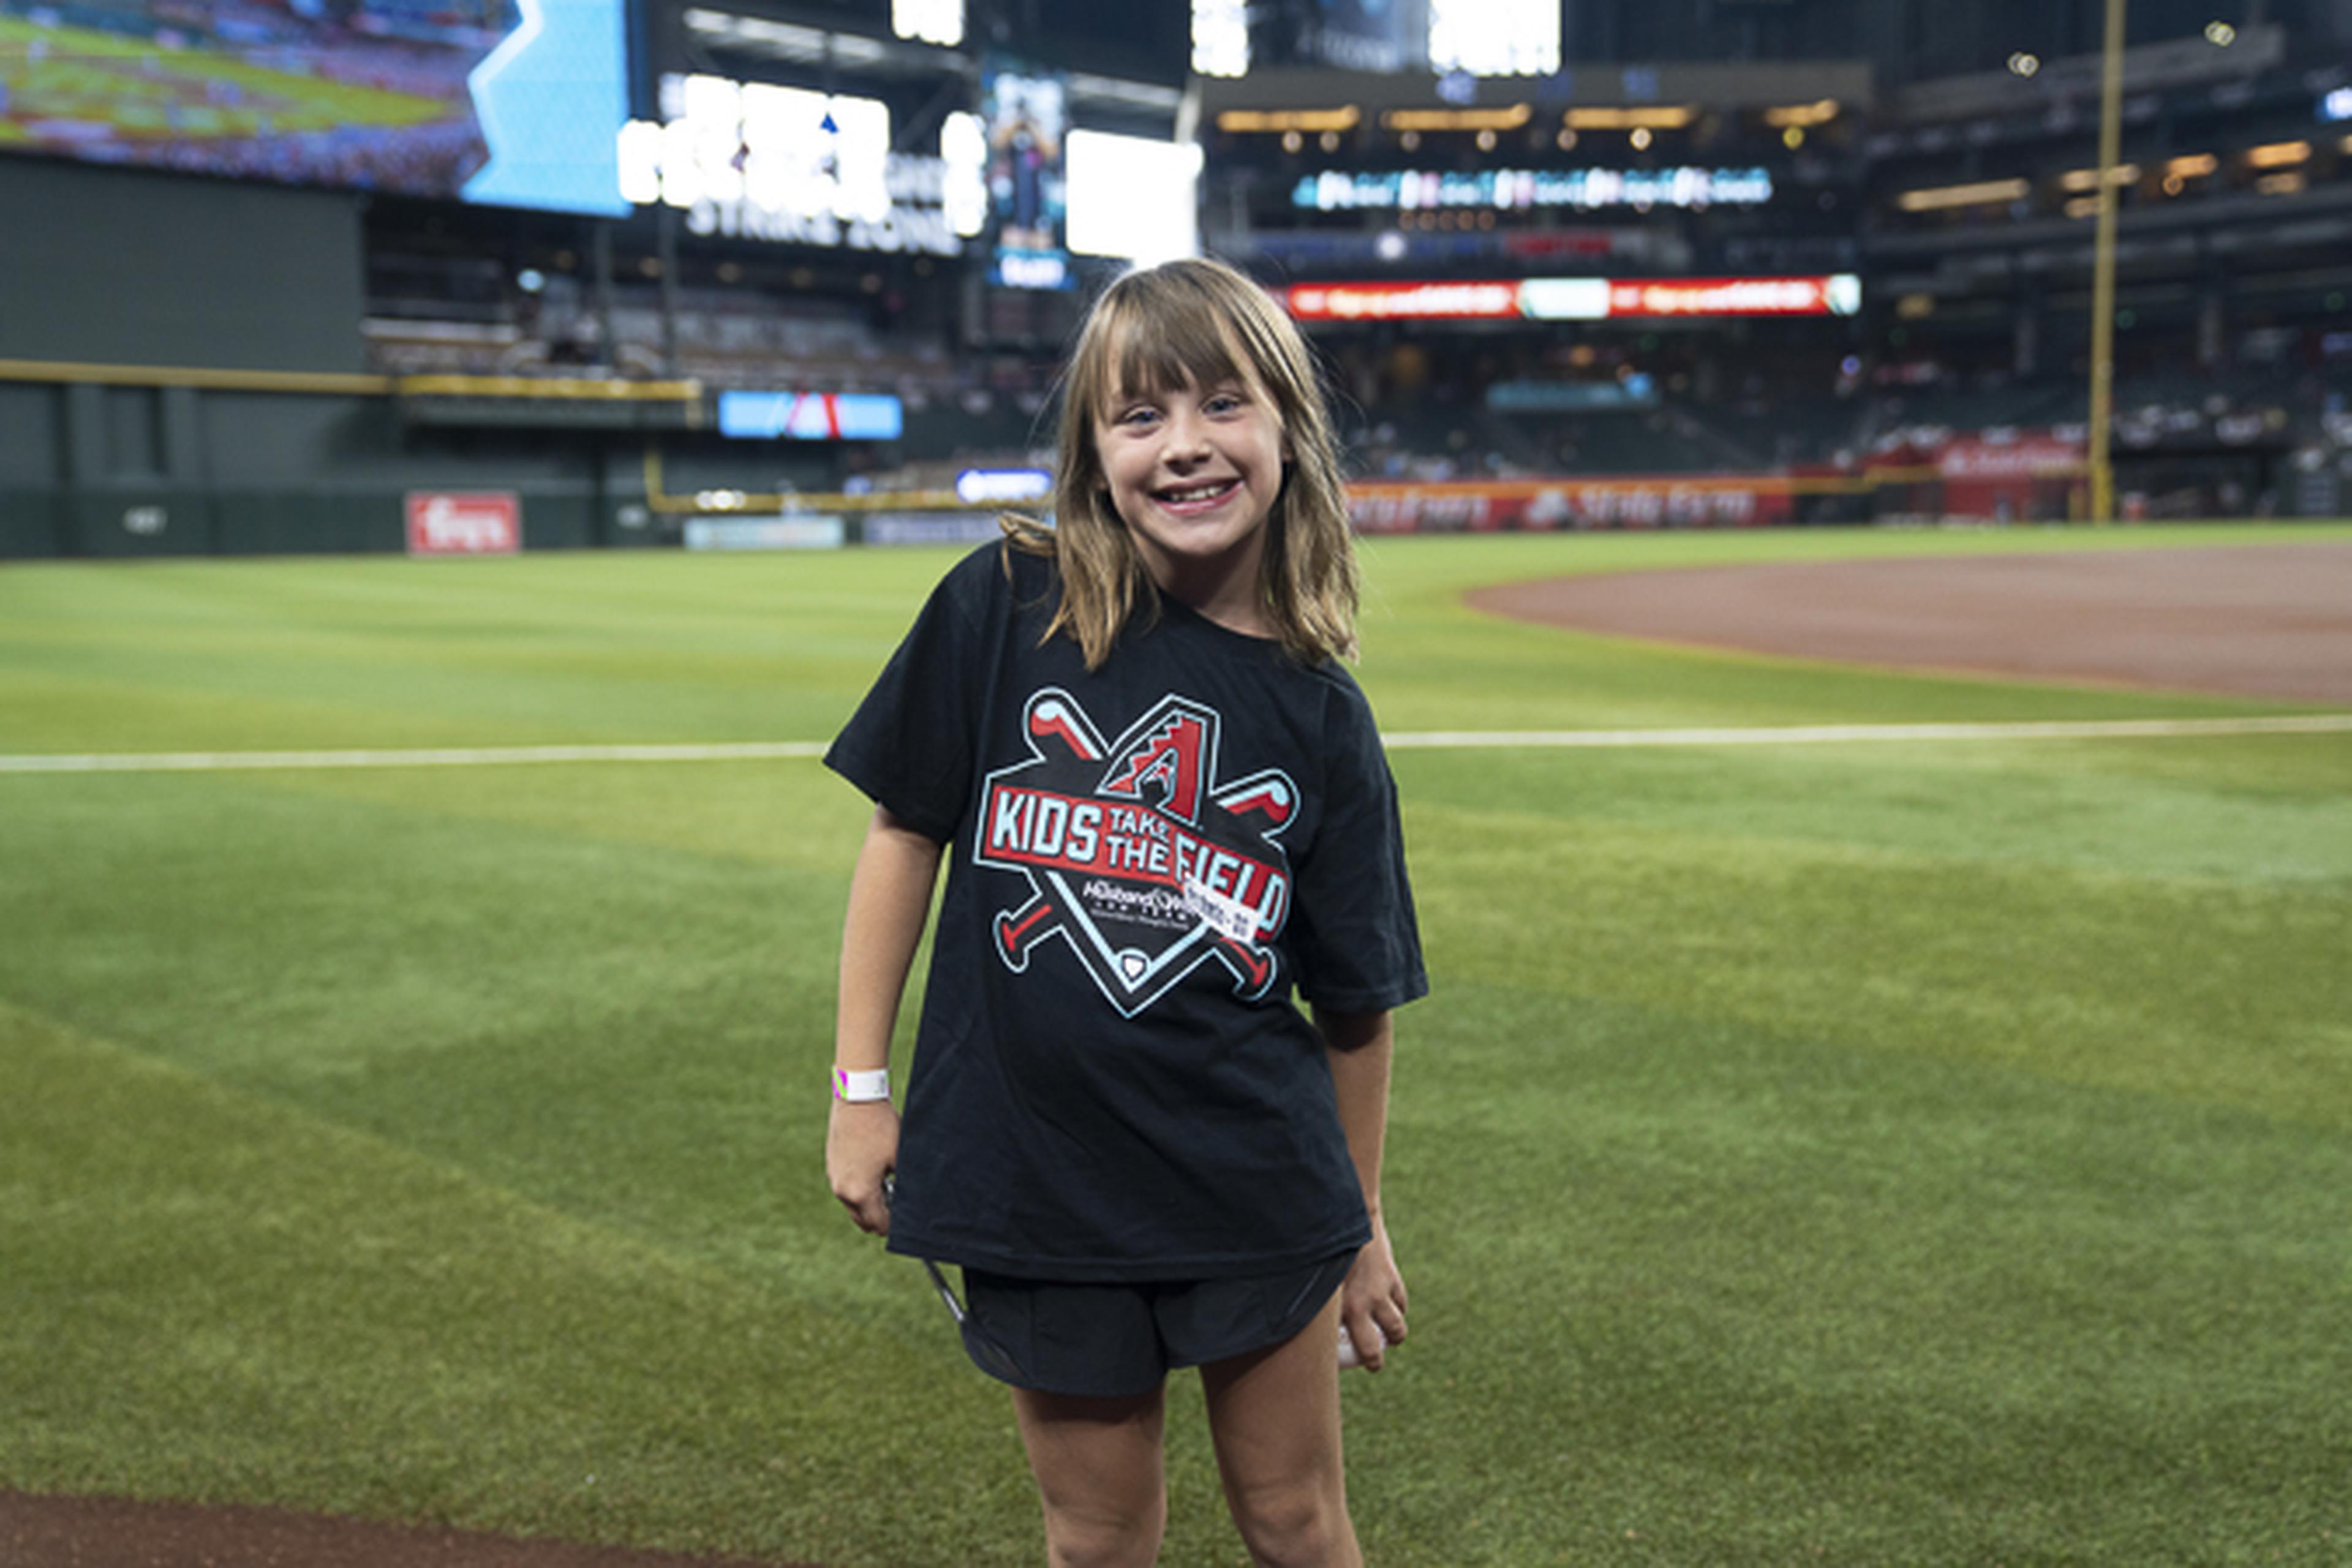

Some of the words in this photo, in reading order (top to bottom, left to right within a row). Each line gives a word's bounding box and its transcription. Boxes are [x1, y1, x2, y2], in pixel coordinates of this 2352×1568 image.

[992, 791, 1102, 862] KIDS
[1109, 808, 1170, 843] TAKE
[1105, 835, 1170, 873] THE
[1175, 832, 1287, 932] FIELD
